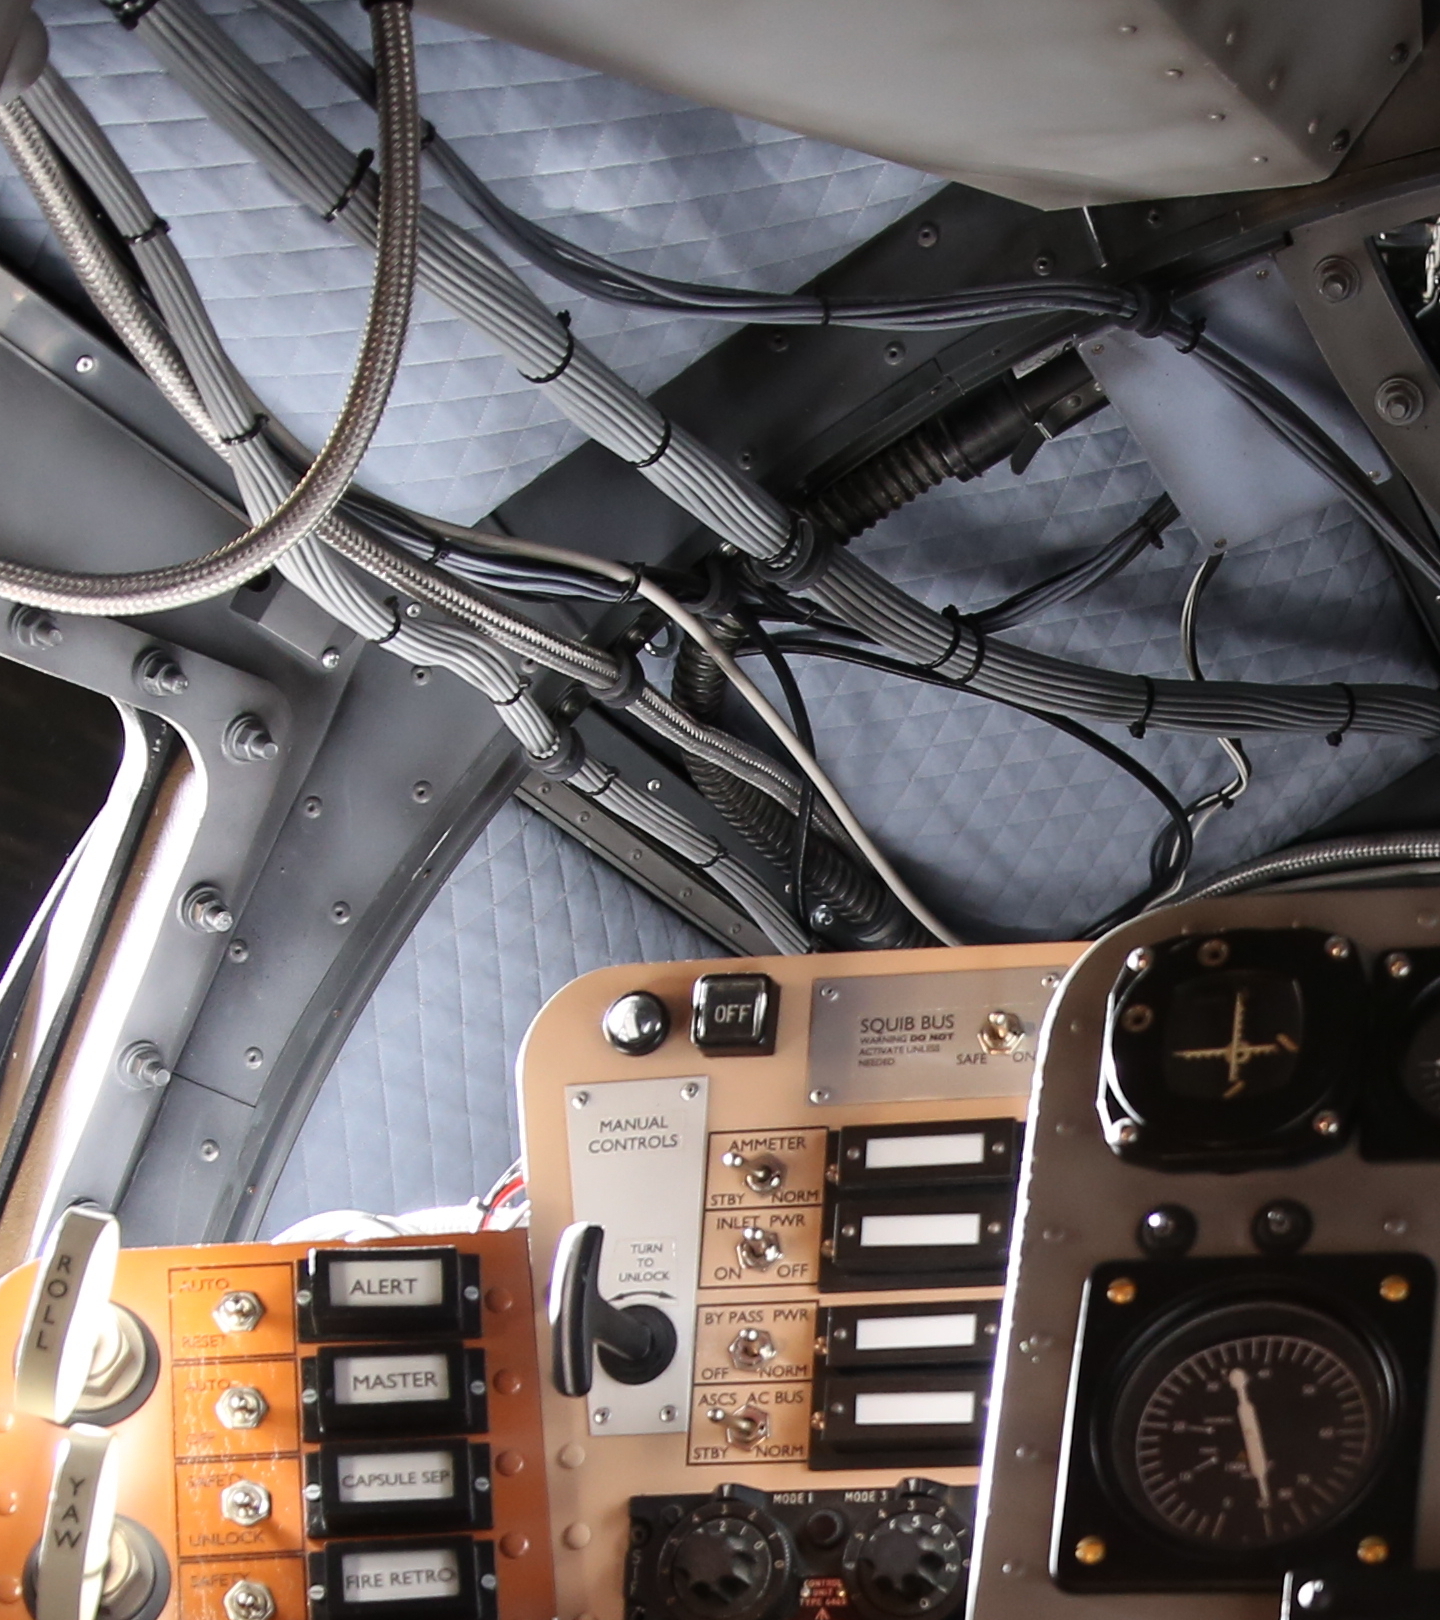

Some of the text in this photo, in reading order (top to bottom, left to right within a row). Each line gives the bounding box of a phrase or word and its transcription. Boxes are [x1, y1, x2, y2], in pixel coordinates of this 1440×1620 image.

[715, 1003, 752, 1024] OFF
[860, 1014, 955, 1034] SQUIB BUS
[860, 1032, 954, 1044] WARNING DO NOT
[859, 1046, 904, 1056] ACTIVATE
[956, 1053, 988, 1066] SAFE
[599, 1117, 669, 1134] MANUAL
[588, 1134, 678, 1154] CONTROLS
[729, 1136, 807, 1153] AMMETER
[710, 1189, 820, 1207] STBY NORM
[716, 1213, 807, 1230] INLET PWR
[630, 1243, 663, 1255] TURN
[637, 1257, 654, 1268] TO
[618, 1271, 670, 1283] UNLOCK
[714, 1264, 810, 1281] ON OFF
[179, 1278, 230, 1293] AUTO
[350, 1277, 419, 1297] ALERT
[35, 1254, 73, 1352] ROLL
[704, 1308, 809, 1325] BY PASS PWR
[181, 1334, 228, 1349] RESET
[701, 1363, 807, 1381] OFF NORM
[184, 1379, 231, 1393] AUTO
[352, 1370, 439, 1392] MASTER
[698, 1389, 805, 1406] ASCS AC BUS
[693, 1444, 804, 1461] STBY NORM
[341, 1468, 452, 1488] CAPSULE SEP
[773, 1493, 804, 1504] MODE
[844, 1490, 889, 1502] MODE 3
[54, 1477, 87, 1550] YAW
[188, 1530, 266, 1546] UNLOCK
[345, 1568, 455, 1590] FIRE RETRO
